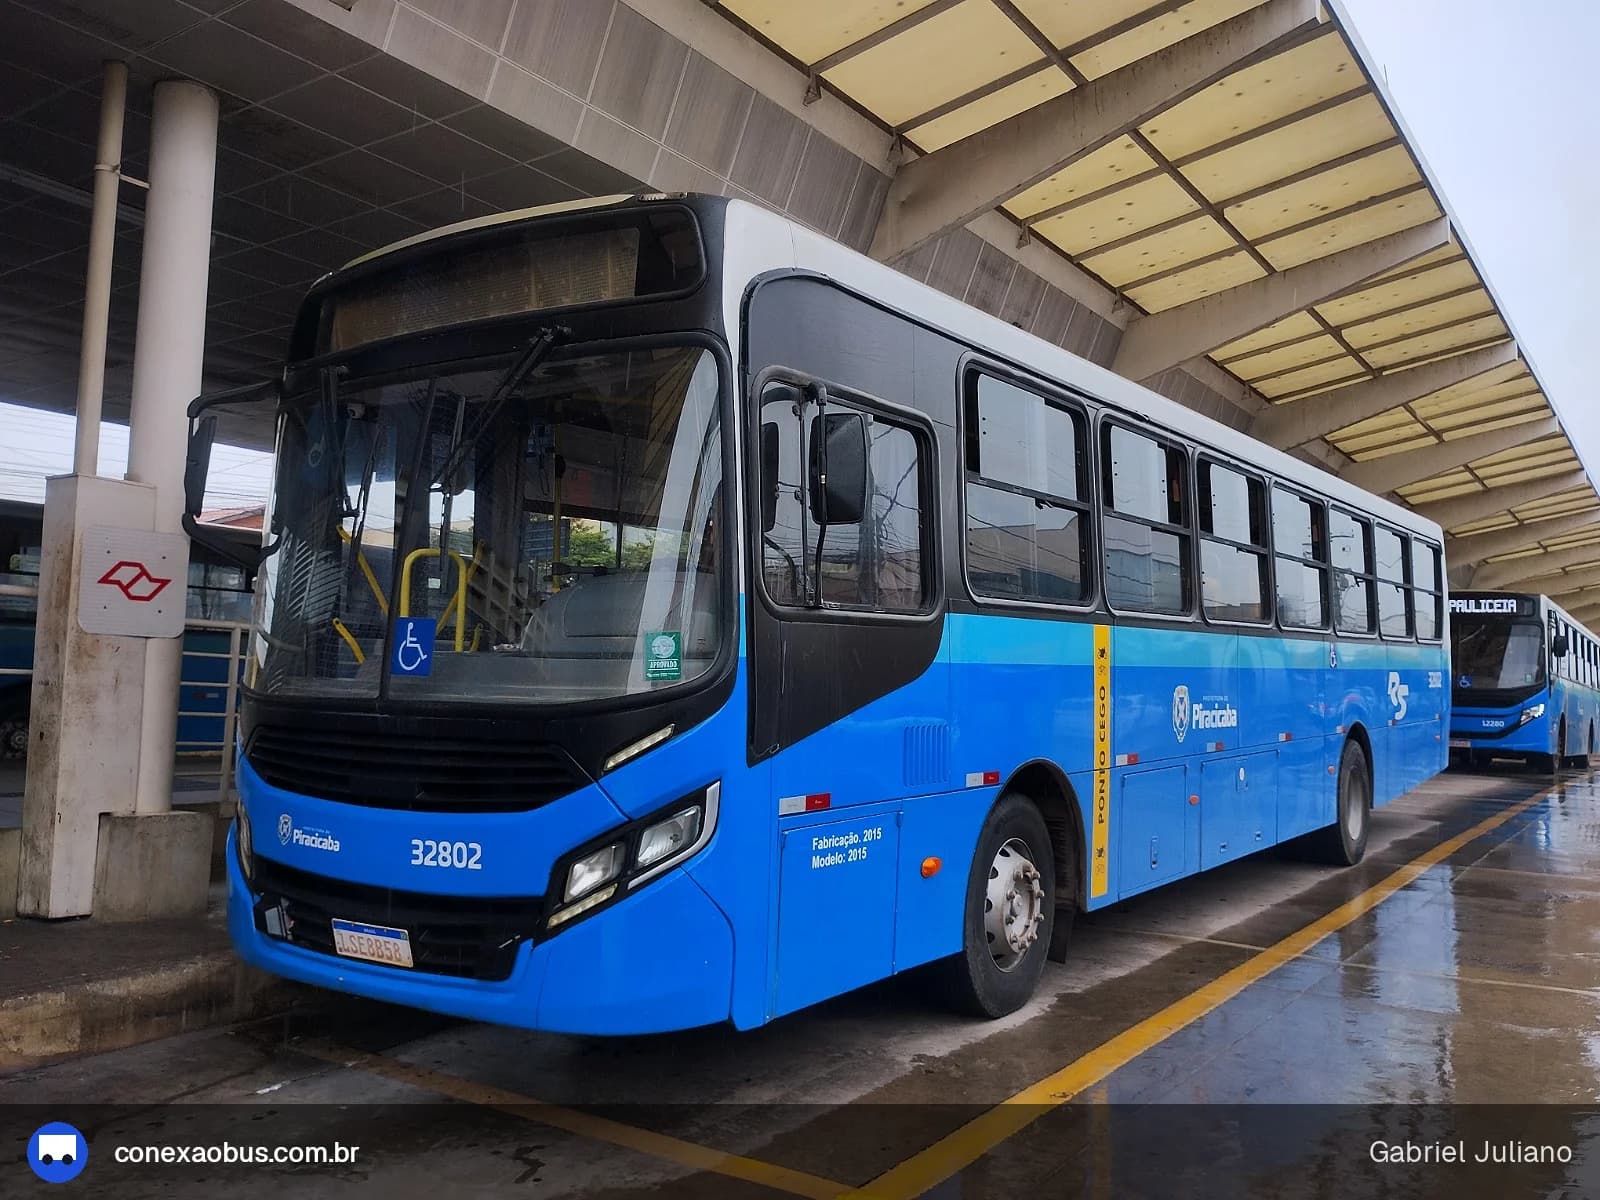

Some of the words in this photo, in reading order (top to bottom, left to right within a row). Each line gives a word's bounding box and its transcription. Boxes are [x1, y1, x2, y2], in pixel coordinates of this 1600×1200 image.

[1449, 599, 1516, 613] PAULICEIA
[649, 660, 678, 669] APROVADO
[1192, 702, 1238, 729] Piracicaba
[292, 828, 340, 852] Piracicaba
[863, 827, 882, 842] 2015
[410, 839, 482, 870] 32802
[811, 852, 847, 869] Modelo:
[847, 846, 867, 862] 2015
